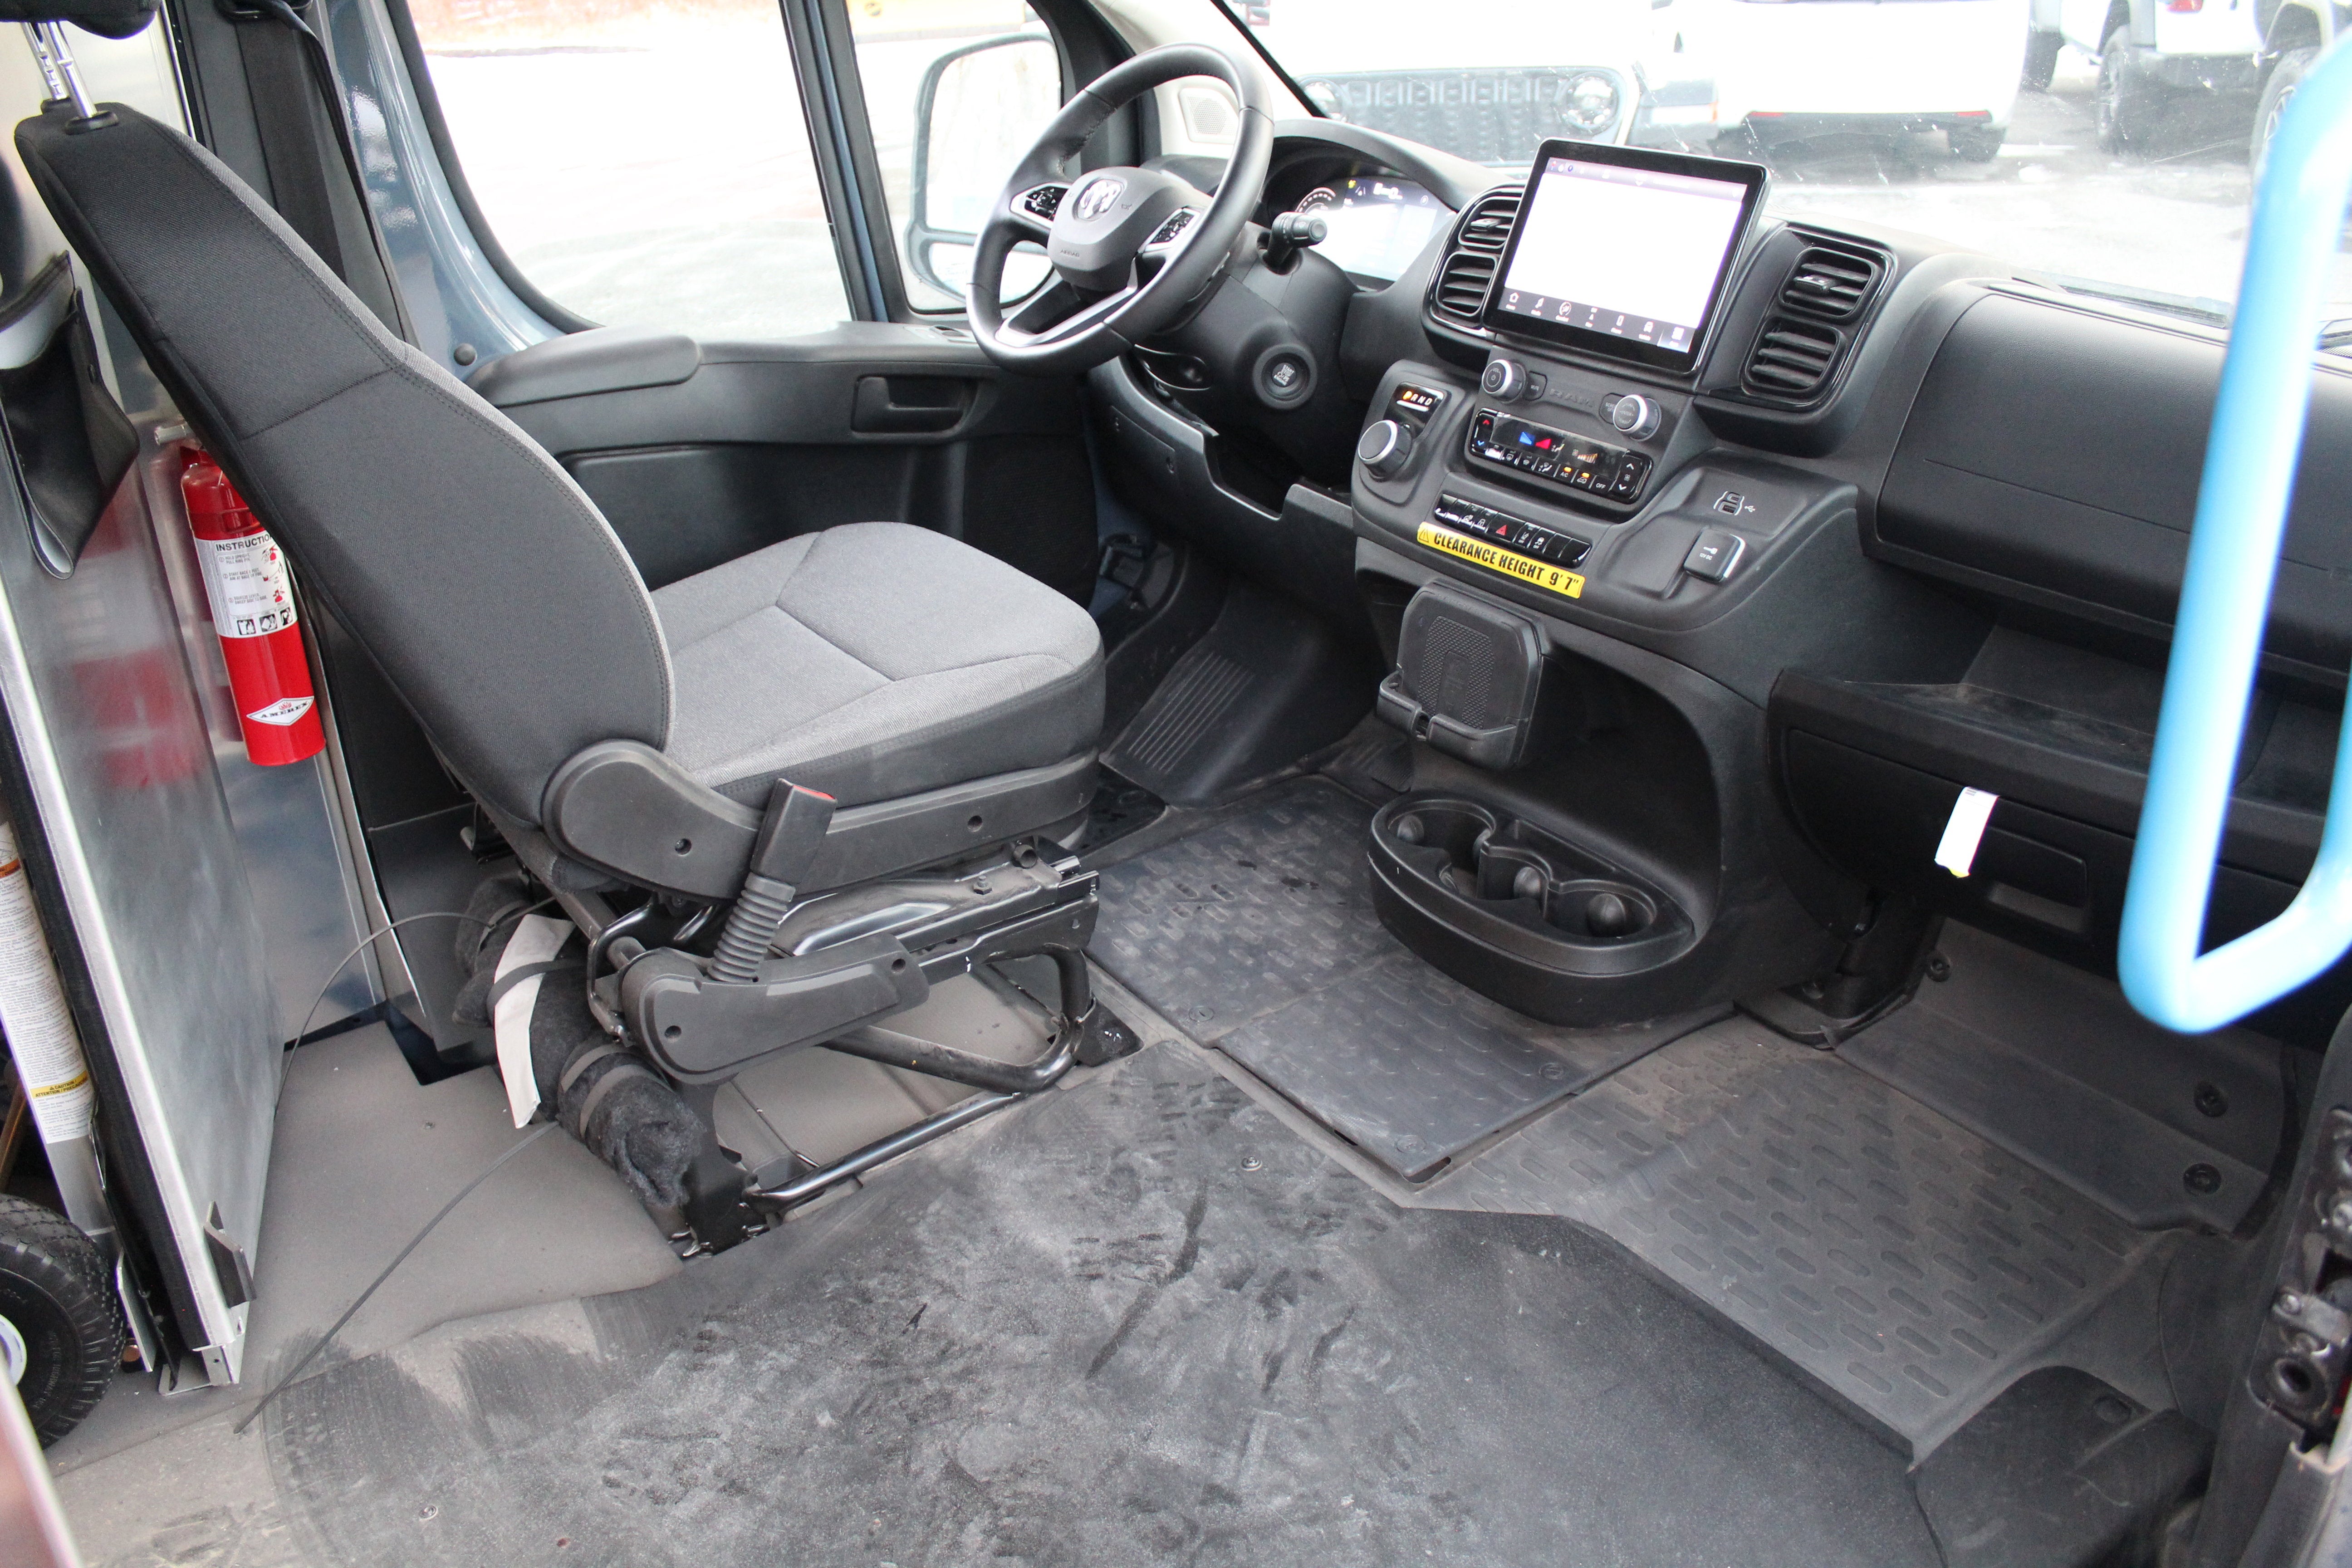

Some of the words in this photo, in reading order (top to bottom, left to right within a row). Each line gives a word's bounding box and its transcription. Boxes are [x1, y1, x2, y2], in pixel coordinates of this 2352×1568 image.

[216, 534, 272, 552] INSTRUCTIO
[1434, 532, 1498, 564] CLEARANCE
[1499, 554, 1545, 581] HEIGHT
[261, 701, 308, 718] AMEREX
[35, 1089, 60, 1098] ATTENTION
